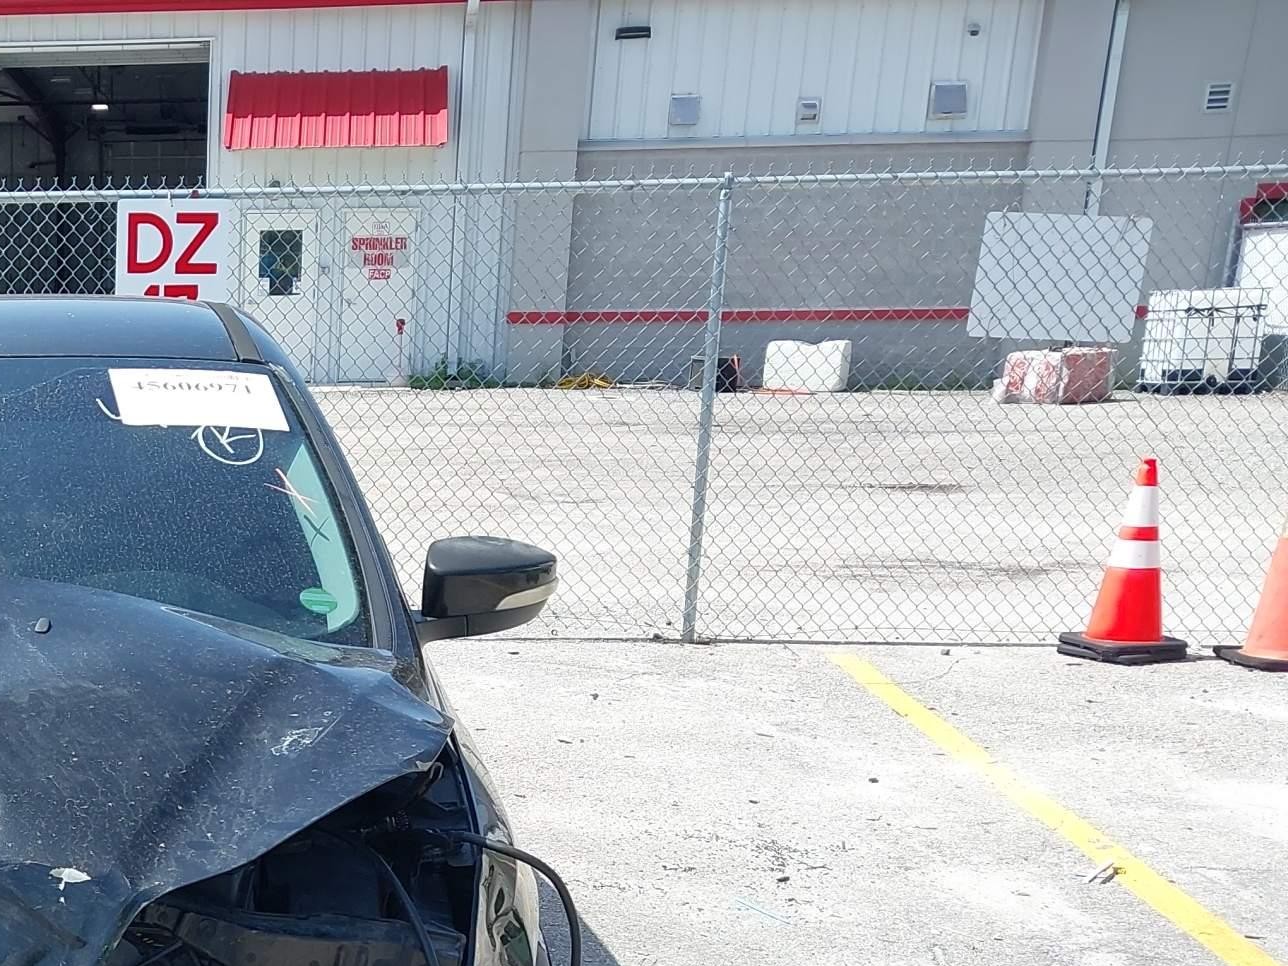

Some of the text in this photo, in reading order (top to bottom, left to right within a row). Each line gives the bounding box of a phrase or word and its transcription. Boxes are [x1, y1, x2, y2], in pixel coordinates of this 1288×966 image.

[127, 212, 219, 275] DZ
[352, 237, 407, 251] SPRINKLER
[363, 253, 394, 266] ROOM
[369, 269, 391, 279] FACP
